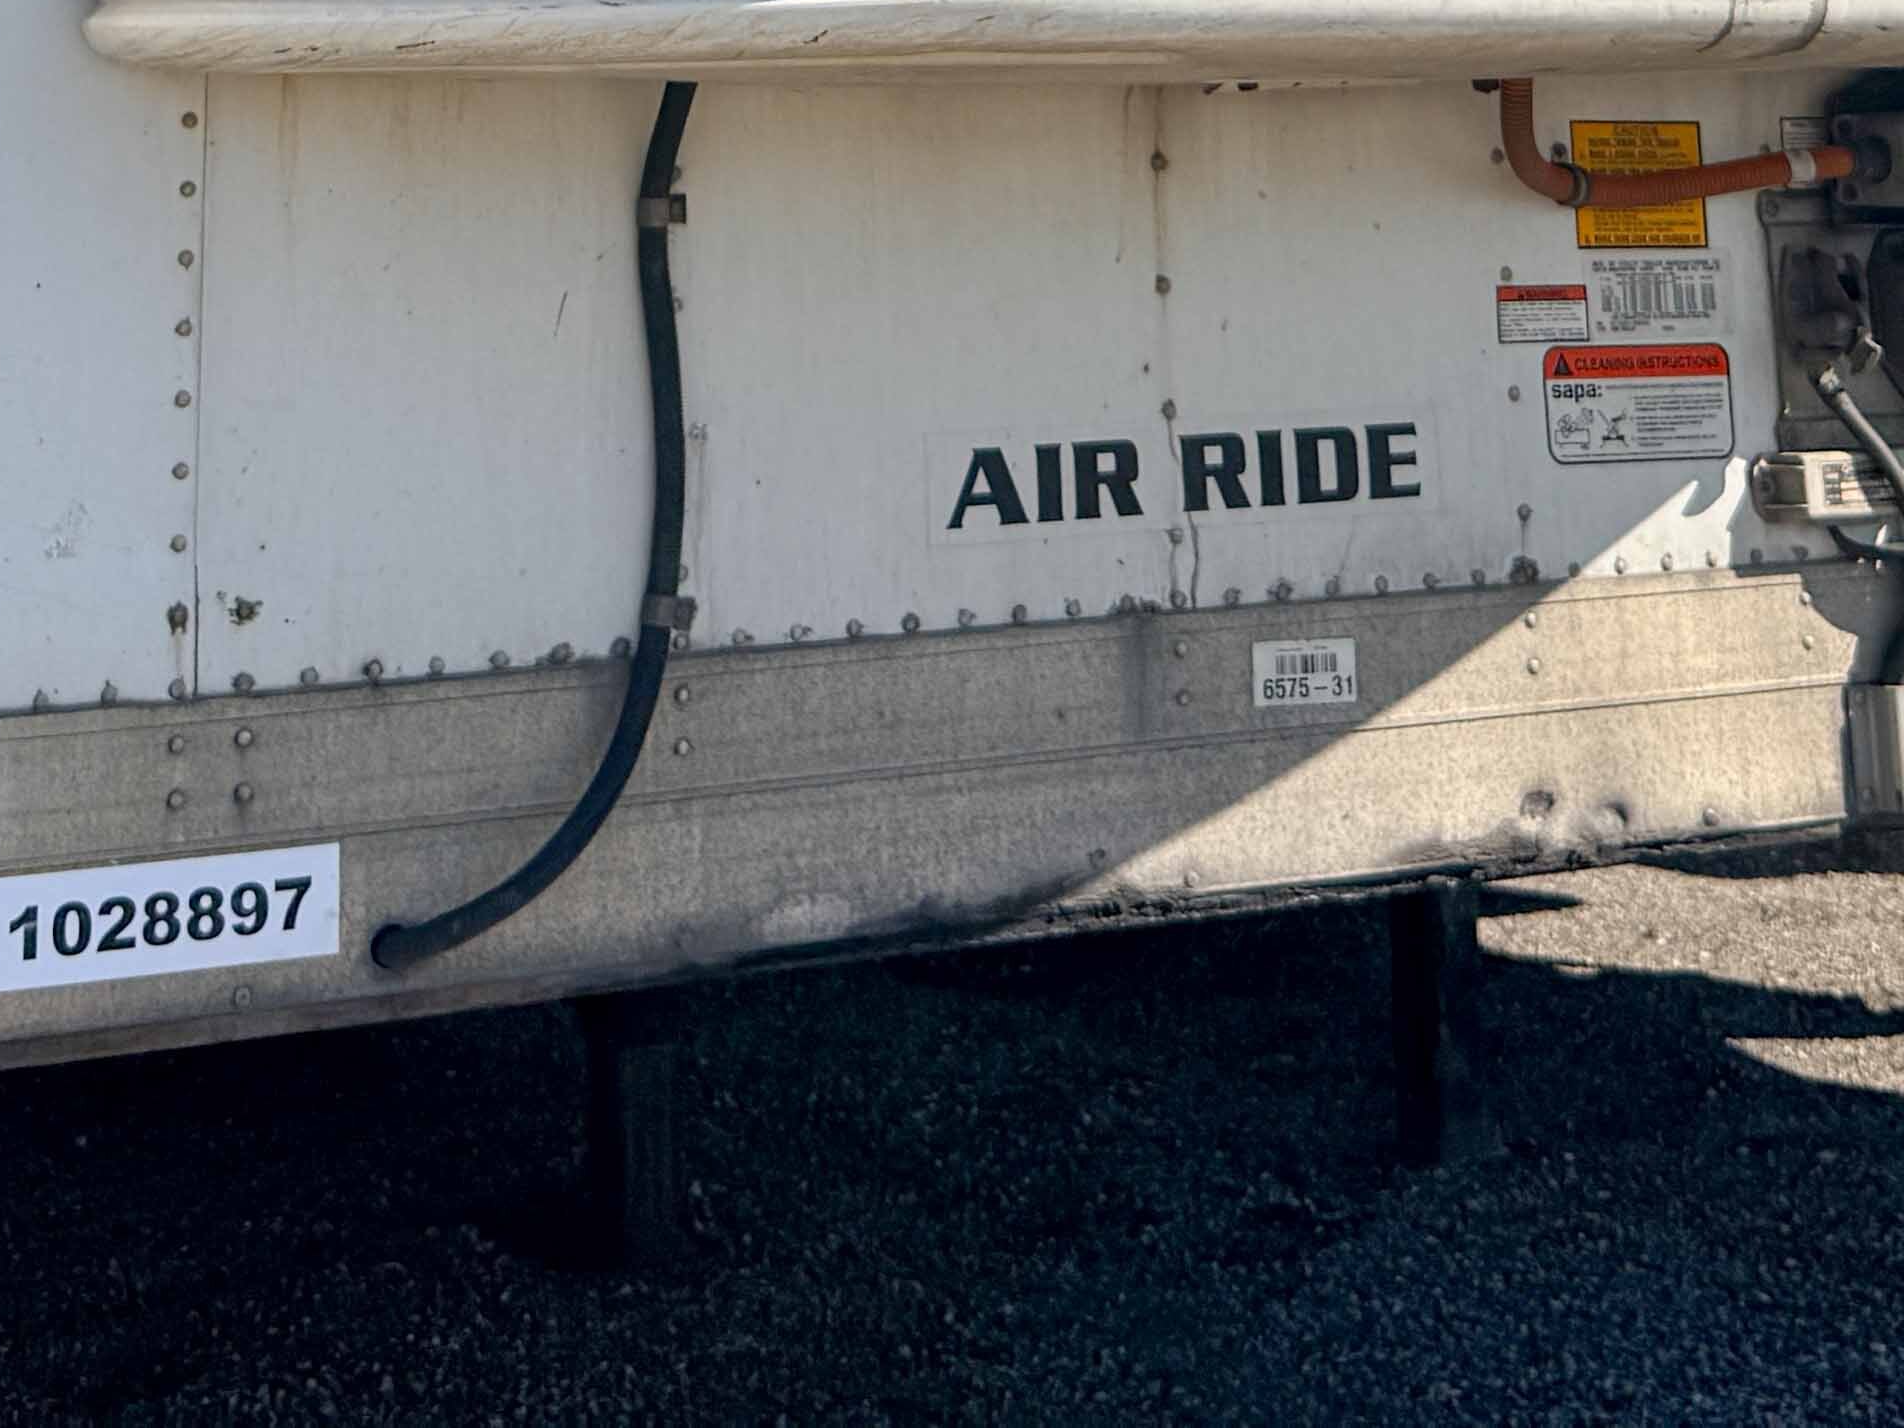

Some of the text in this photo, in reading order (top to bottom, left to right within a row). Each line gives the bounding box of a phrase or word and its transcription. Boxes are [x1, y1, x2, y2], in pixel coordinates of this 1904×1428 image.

[1574, 354, 1720, 371] CLEANING INSTRUCTIONS
[946, 422, 1422, 529] AIR RIDE
[9, 875, 313, 961] 1028897
